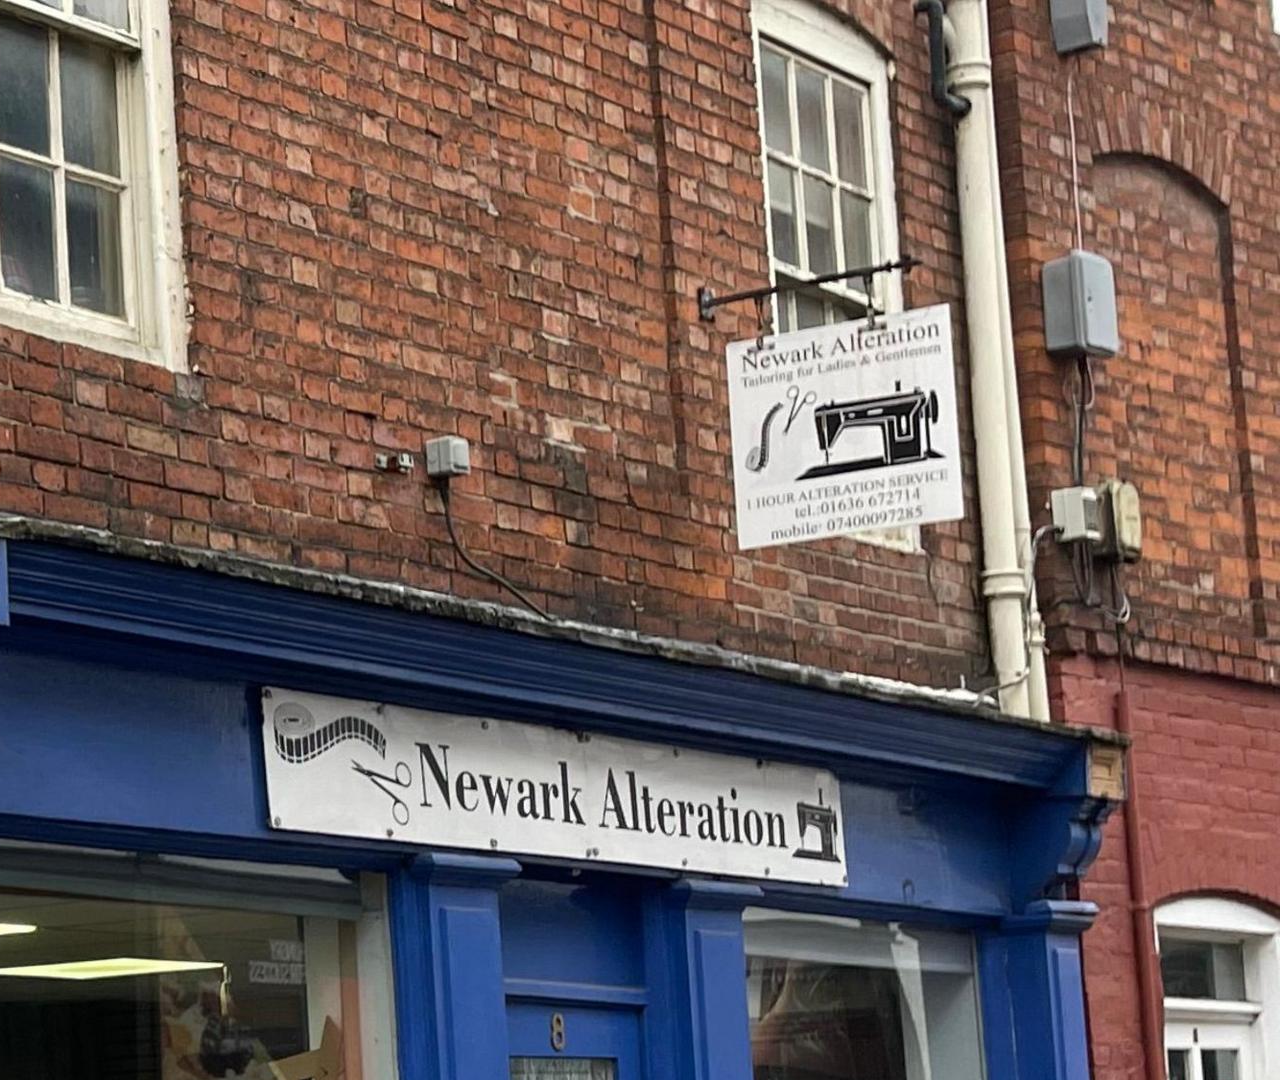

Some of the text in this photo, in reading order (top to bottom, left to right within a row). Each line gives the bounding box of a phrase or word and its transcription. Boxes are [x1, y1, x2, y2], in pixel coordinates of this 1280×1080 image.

[741, 343, 942, 389] Tailoring for Ladies & Gentlemen
[742, 321, 941, 374] Newark Alteration
[746, 469, 949, 510] 1 HOUR ALTERATION SERVICE
[868, 488, 921, 508] 672714
[415, 741, 790, 849] Newark Alteration
[550, 1012, 566, 1051] 8
